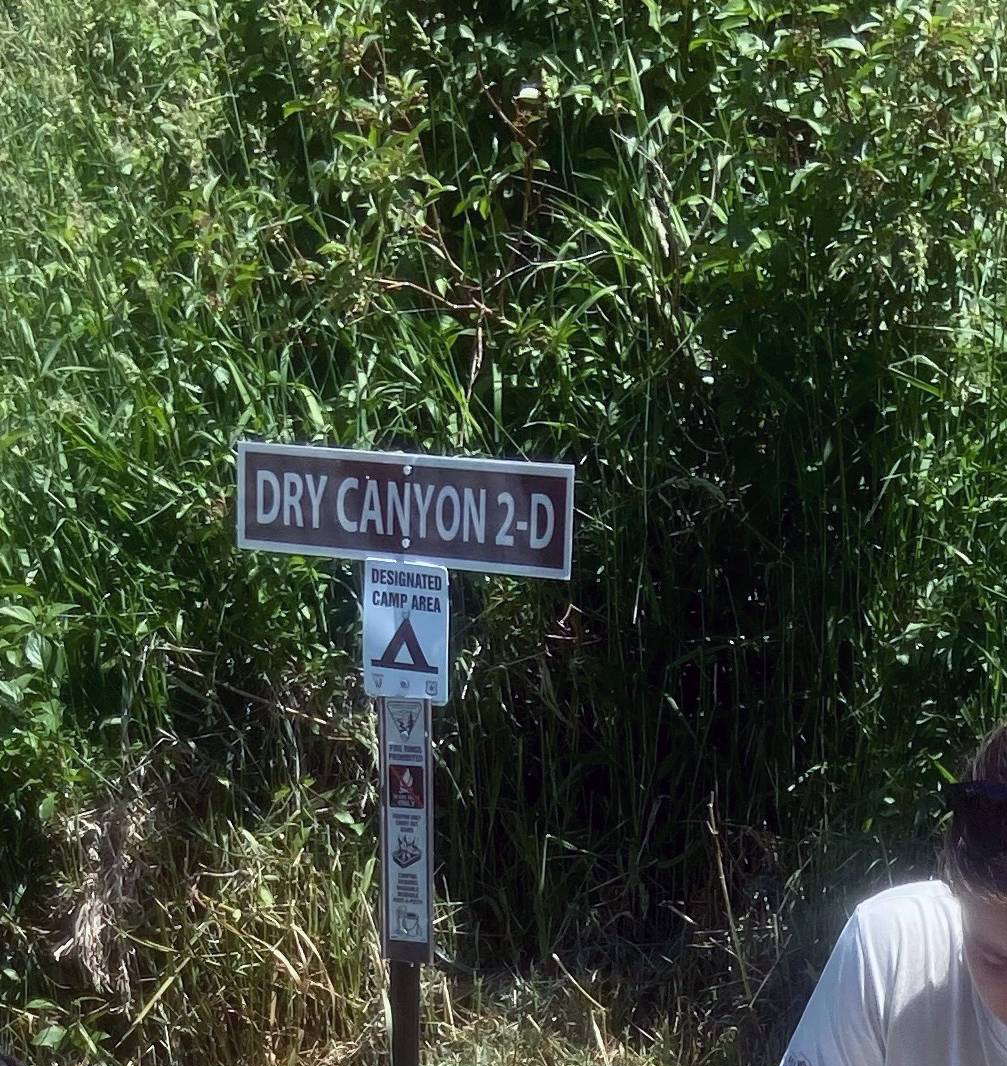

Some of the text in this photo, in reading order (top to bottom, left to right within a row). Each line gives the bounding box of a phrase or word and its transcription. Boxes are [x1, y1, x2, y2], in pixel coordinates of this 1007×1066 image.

[255, 469, 556, 551] DRY CANYON 2-D
[371, 567, 442, 591] DESIGNATED
[372, 590, 442, 613] CAMP AREA
